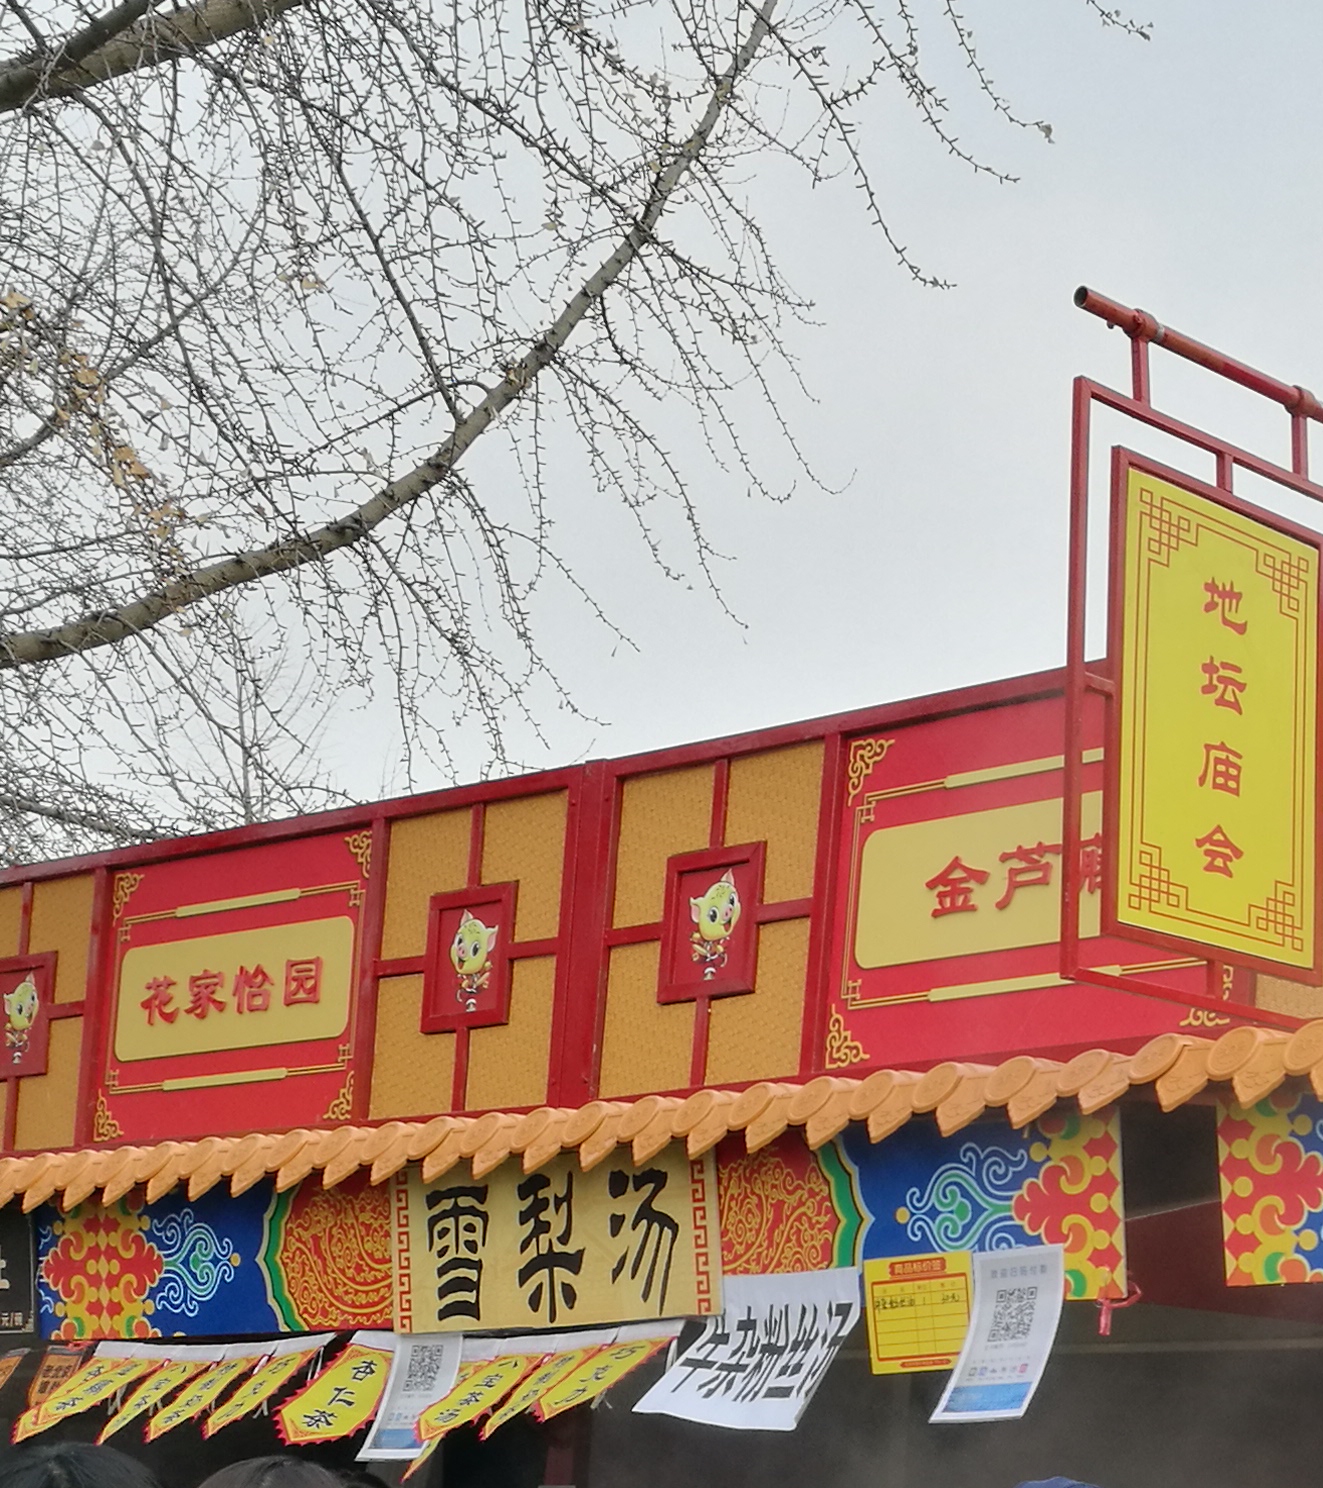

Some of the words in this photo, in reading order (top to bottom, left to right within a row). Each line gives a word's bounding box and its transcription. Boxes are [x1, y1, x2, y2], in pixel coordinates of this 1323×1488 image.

[1194, 577, 1248, 878] 地坛庙会
[140, 956, 324, 1027] 花家怡园
[425, 1168, 679, 1322] 雪梨汤
[301, 1358, 379, 1430] 杏仁茶
